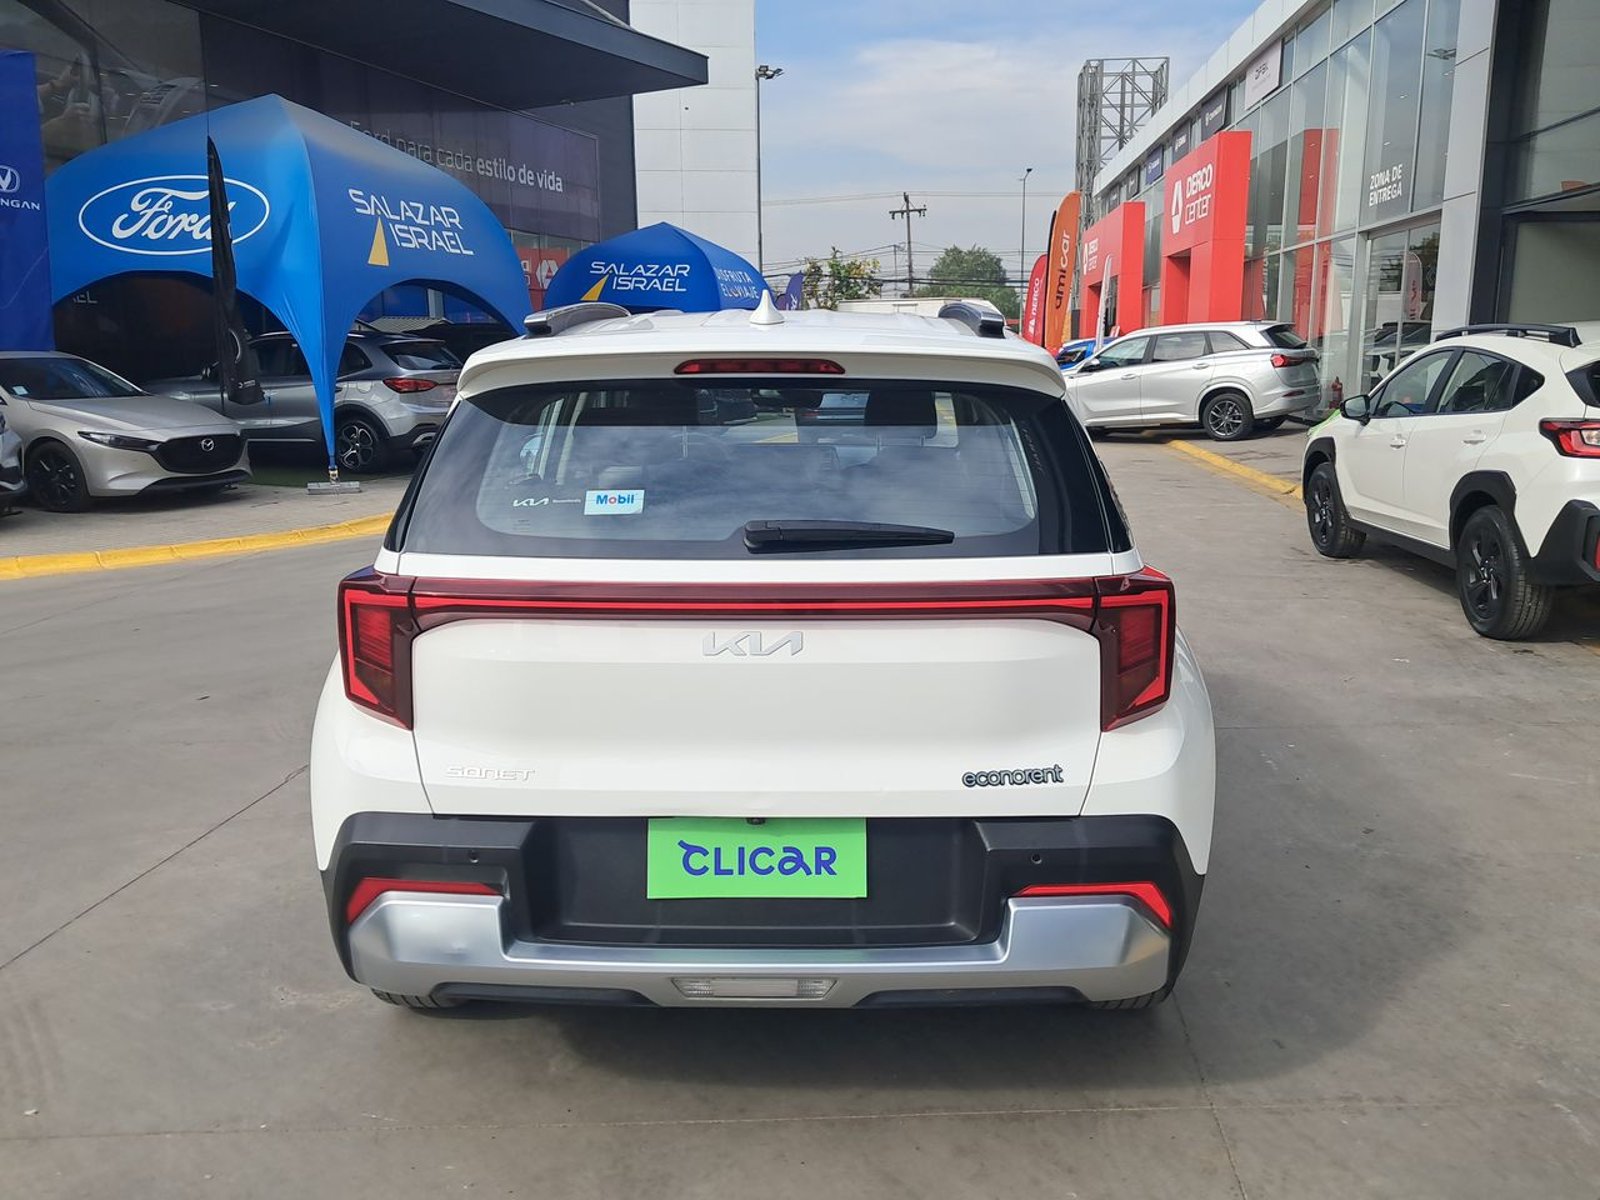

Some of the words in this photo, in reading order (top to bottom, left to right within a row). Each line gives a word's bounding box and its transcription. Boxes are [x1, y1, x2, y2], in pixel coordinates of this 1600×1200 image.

[436, 148, 473, 173] cada
[477, 157, 515, 182] estilo
[518, 163, 535, 186] de
[537, 169, 563, 192] vida
[1370, 170, 1391, 190] ZONA
[1391, 164, 1403, 182] DE
[1369, 181, 1402, 206] ENTREGA
[348, 188, 464, 230] SALAZAR
[388, 222, 475, 256] ISRAEL
[589, 261, 690, 277] SALAZAR
[1055, 229, 1071, 310] amicar
[612, 276, 687, 292] ISRAEL
[595, 494, 635, 505] Mobil
[702, 630, 805, 657] KIA
[446, 765, 536, 782] SONET
[961, 763, 1065, 788] econorent
